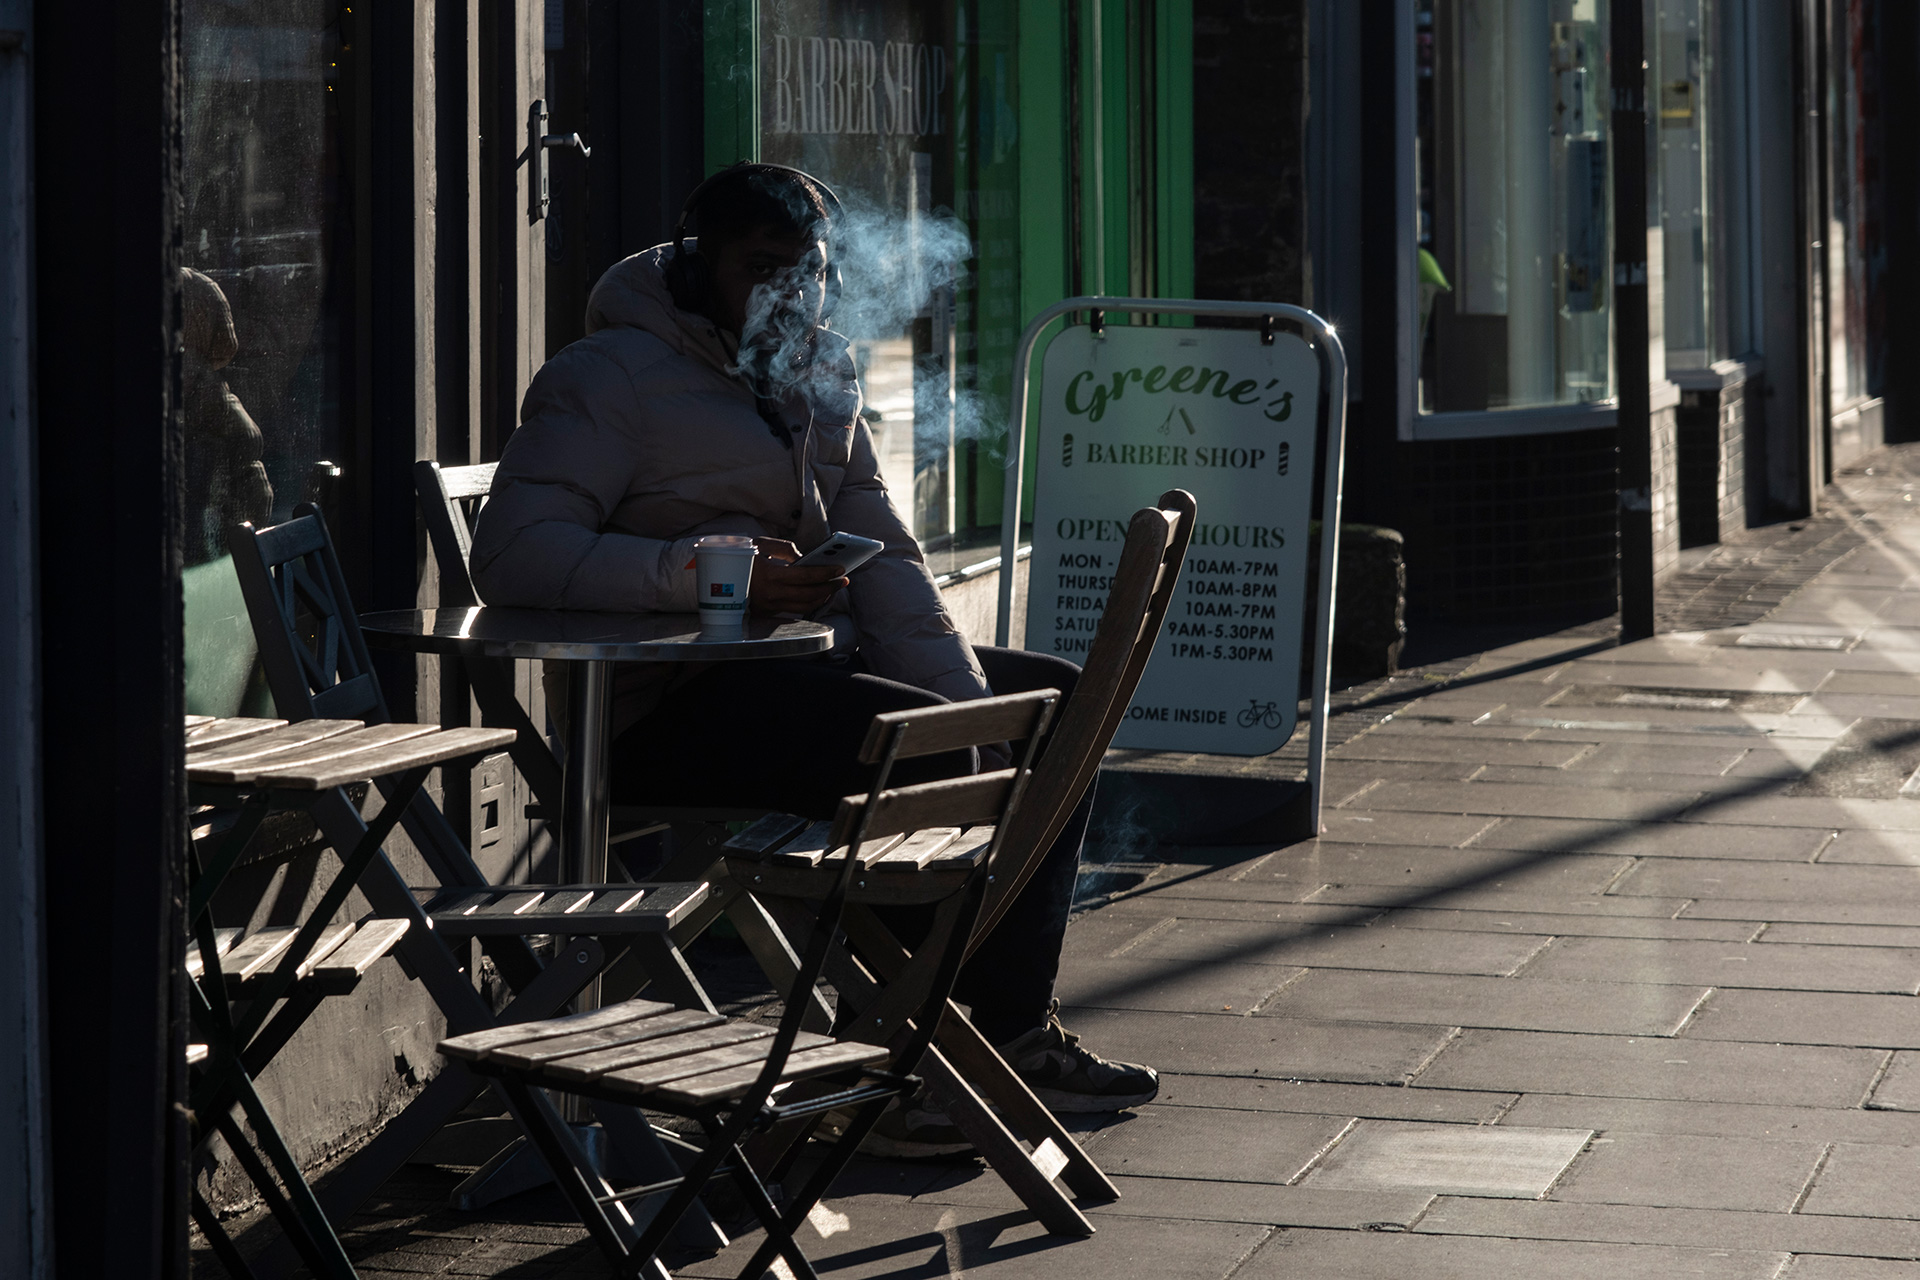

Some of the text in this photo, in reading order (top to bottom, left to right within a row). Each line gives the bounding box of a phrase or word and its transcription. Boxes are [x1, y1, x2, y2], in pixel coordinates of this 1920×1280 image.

[773, 34, 946, 136] BARBER SHOP
[1065, 366, 1293, 422] Greene's
[1087, 443, 1265, 469] BARBER SHOP
[1191, 524, 1285, 549] HOURS
[1059, 553, 1101, 568] MON
[1188, 559, 1279, 576] 10AM-7PM
[1187, 580, 1277, 598] 10AM-8PM
[1057, 596, 1276, 619] FRIDA 10AM-7PM
[1055, 616, 1274, 640] SATU 9AM-5.30PM
[1171, 643, 1273, 661] 1PM-5.30PM
[1174, 708, 1226, 724] INSIDE
